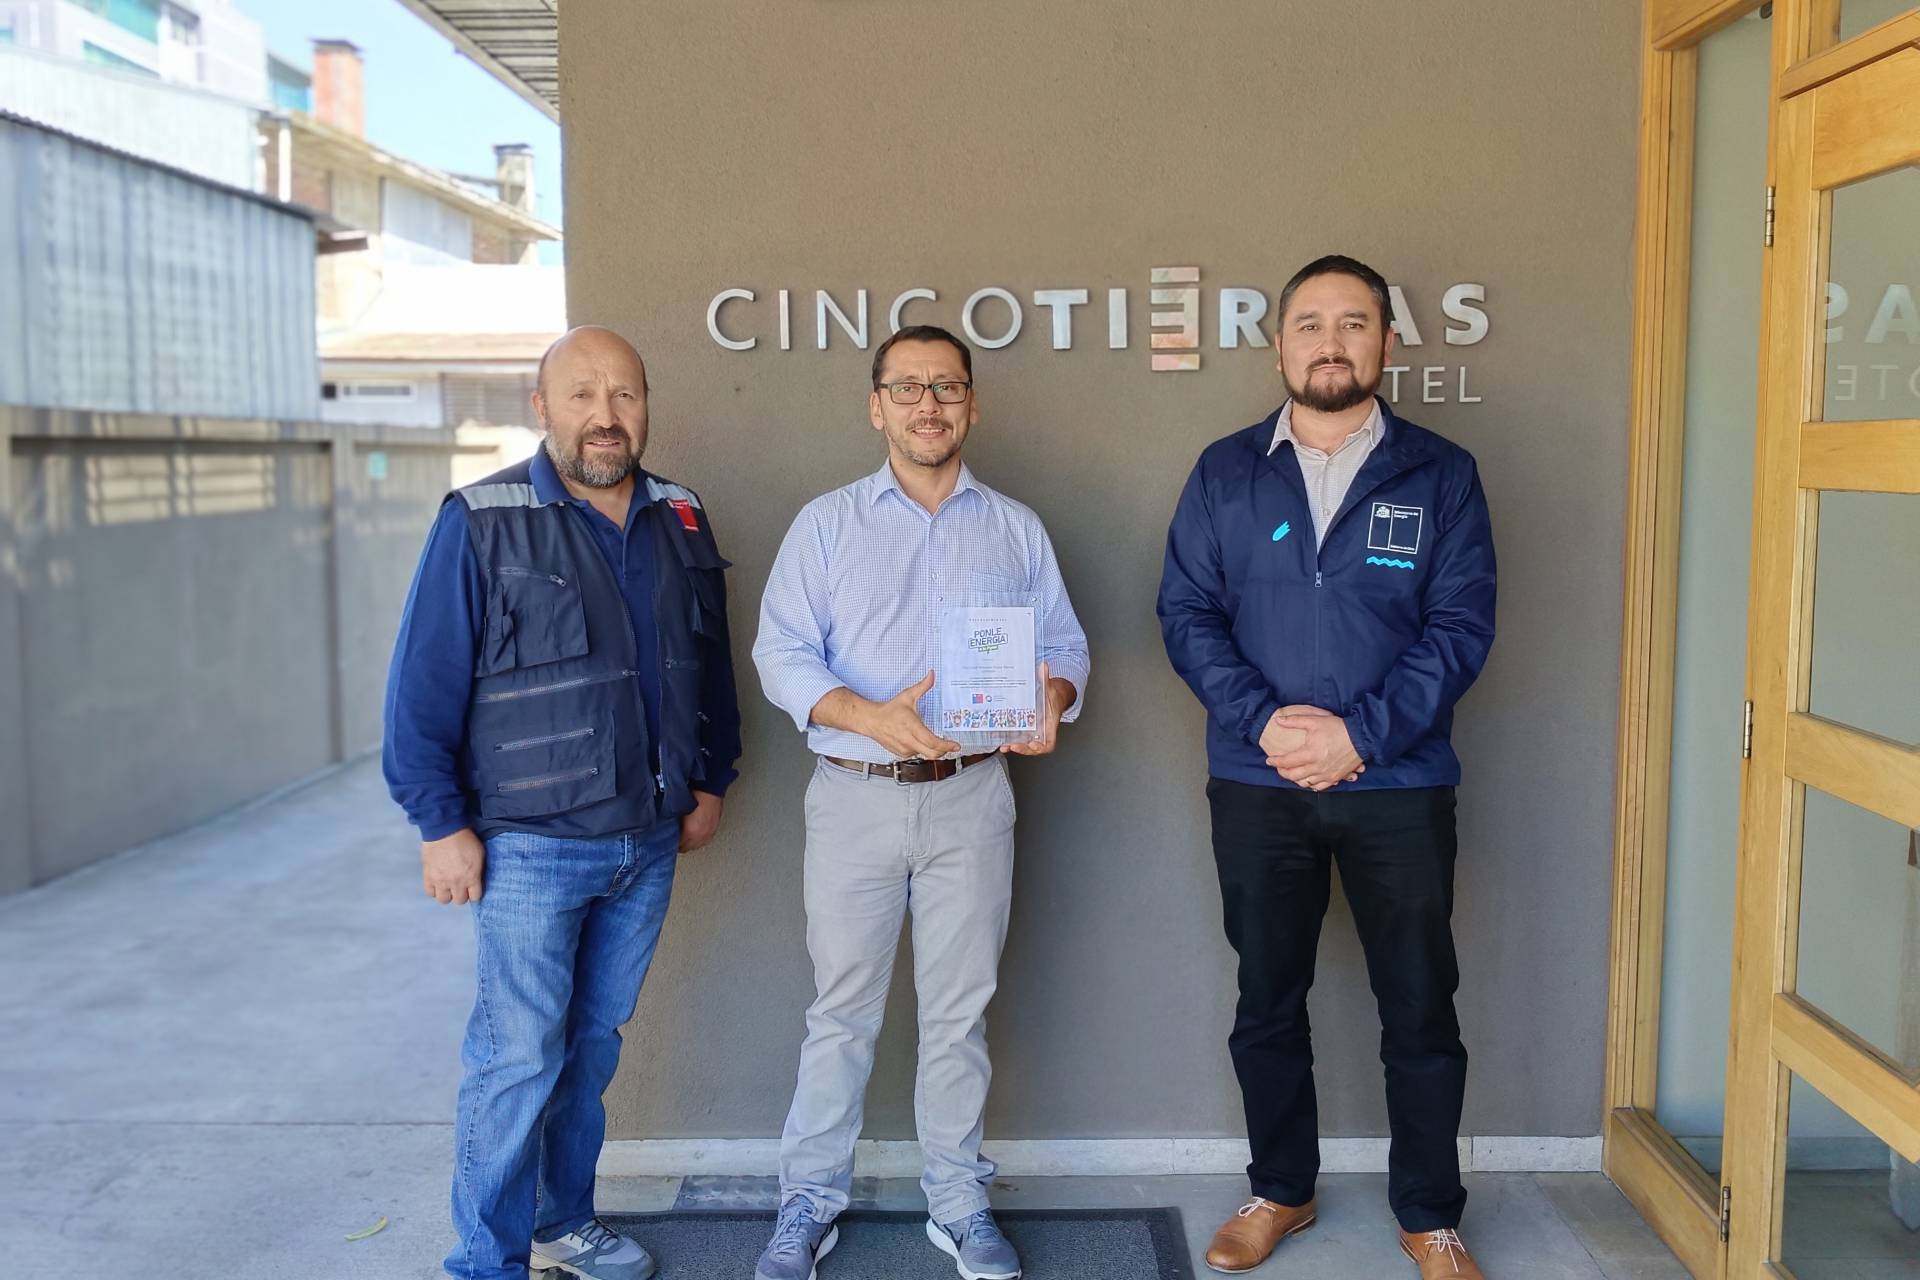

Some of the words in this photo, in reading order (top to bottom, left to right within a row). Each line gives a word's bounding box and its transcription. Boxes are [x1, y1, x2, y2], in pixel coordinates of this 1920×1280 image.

[707, 266, 1489, 371] CINCOTIERAS
[1383, 366, 1482, 404] TEL
[974, 627, 1002, 638] PONLE
